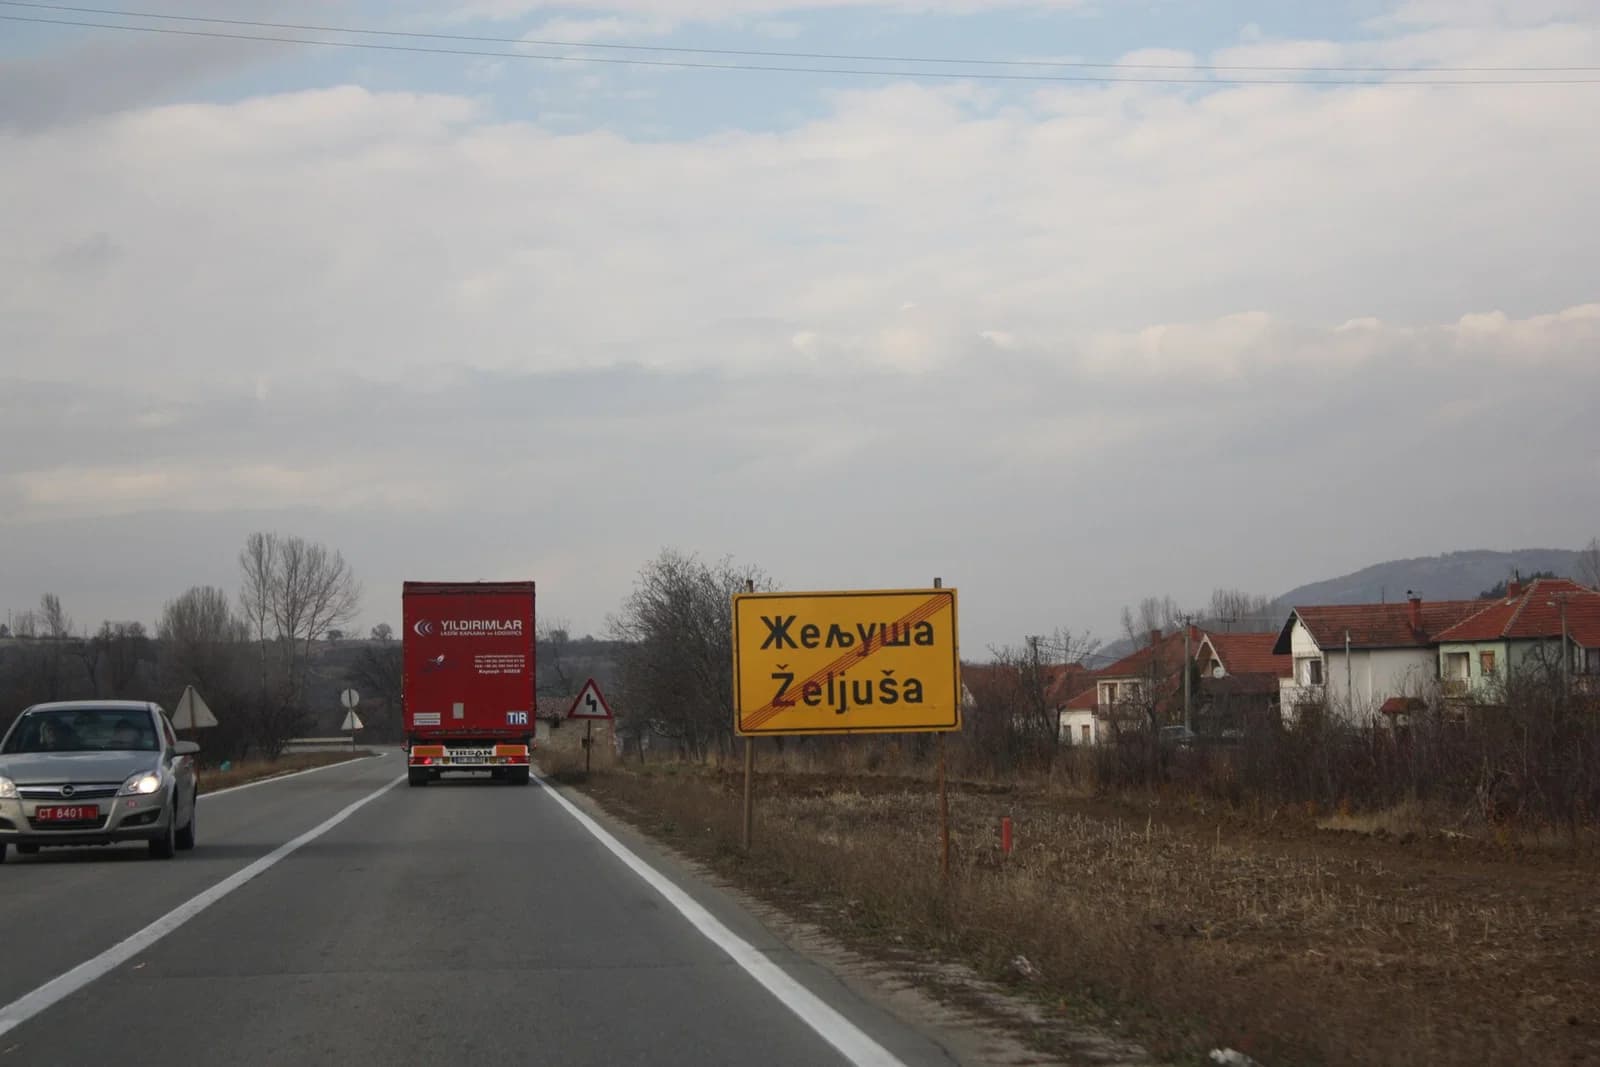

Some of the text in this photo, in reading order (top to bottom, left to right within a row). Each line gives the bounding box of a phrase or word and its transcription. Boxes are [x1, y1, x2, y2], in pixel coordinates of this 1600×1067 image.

[441, 619, 522, 630] YILDIRIMLAR
[760, 615, 934, 657] Жељуша
[771, 664, 923, 714] Željuša
[508, 711, 528, 725] TIR
